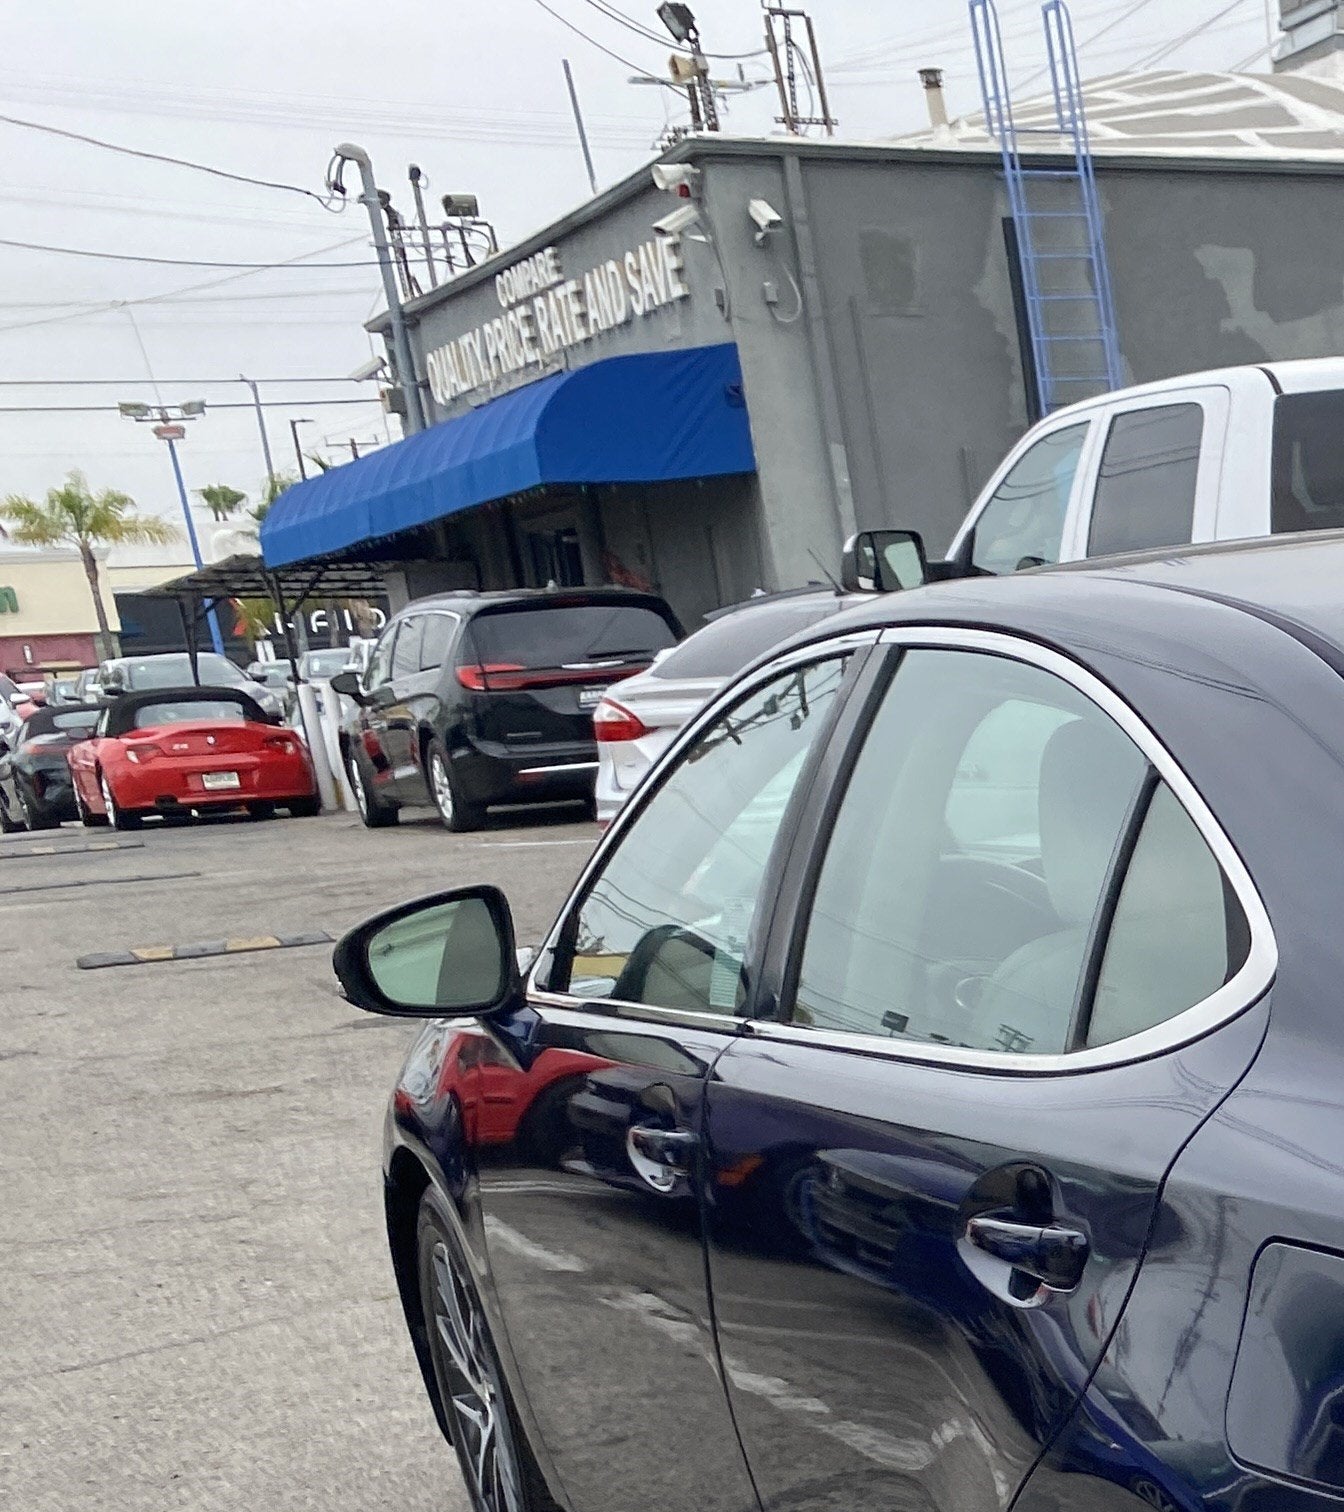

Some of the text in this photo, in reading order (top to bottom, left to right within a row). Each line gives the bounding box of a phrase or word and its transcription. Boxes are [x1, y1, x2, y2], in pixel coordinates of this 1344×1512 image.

[495, 246, 563, 308] COMPARE
[533, 279, 586, 354] RATE
[585, 259, 626, 334] AND
[624, 236, 689, 316] SAVE
